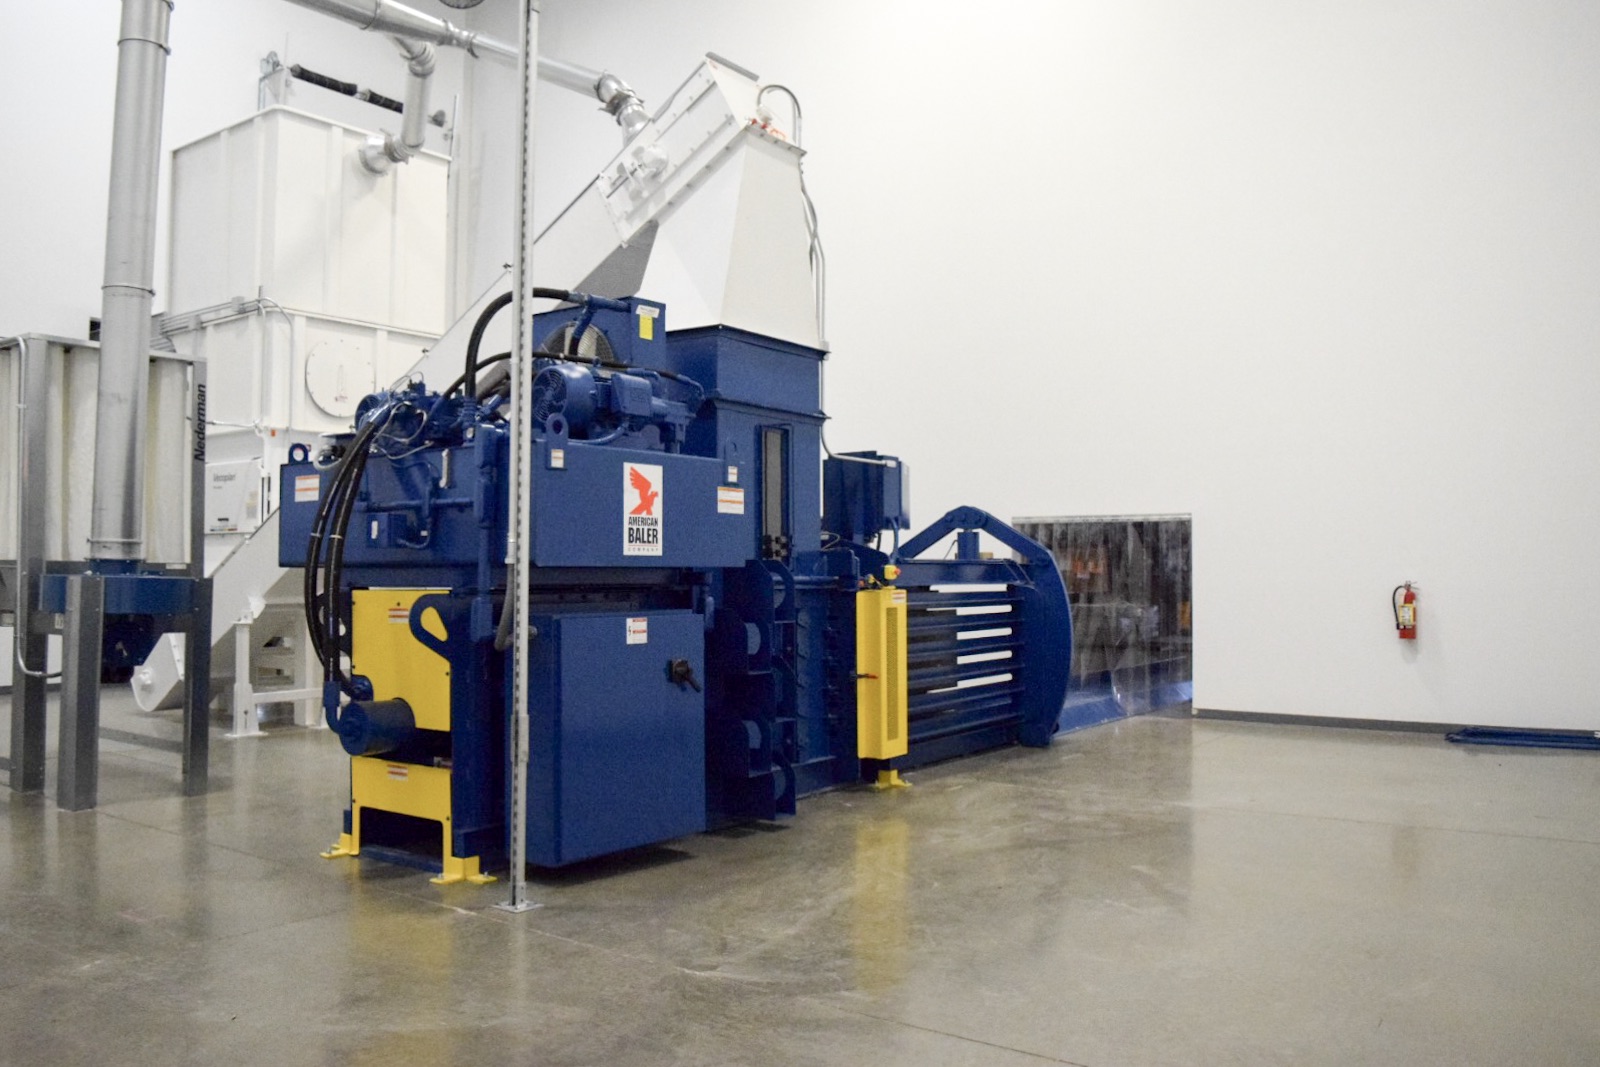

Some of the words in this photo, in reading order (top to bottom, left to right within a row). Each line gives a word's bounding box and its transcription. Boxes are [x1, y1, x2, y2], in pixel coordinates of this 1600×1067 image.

[194, 384, 206, 461] Nederman
[628, 516, 658, 526] AMERICAN
[628, 528, 658, 544] BALER
